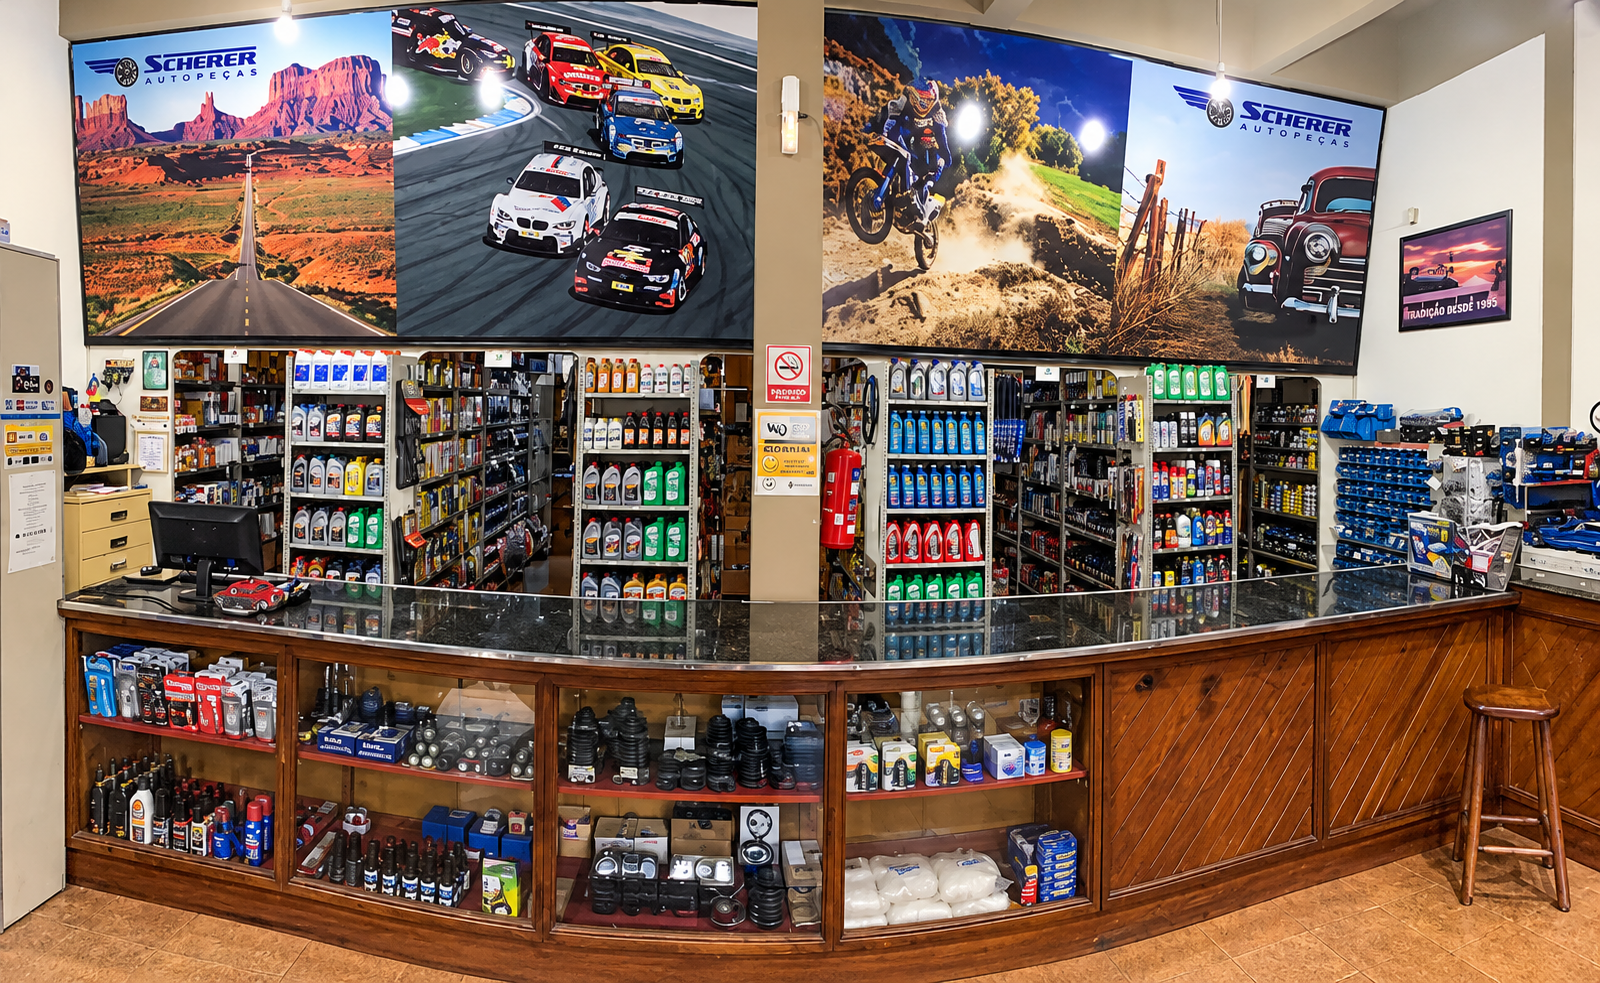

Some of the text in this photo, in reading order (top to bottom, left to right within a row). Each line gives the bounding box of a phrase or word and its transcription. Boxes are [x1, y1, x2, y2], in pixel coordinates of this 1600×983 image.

[144, 46, 257, 74] SCHERER
[144, 68, 258, 86] AUTOPEÇAS
[1239, 100, 1353, 138] SCHERER
[1239, 122, 1350, 149] AUTOPEÇAS
